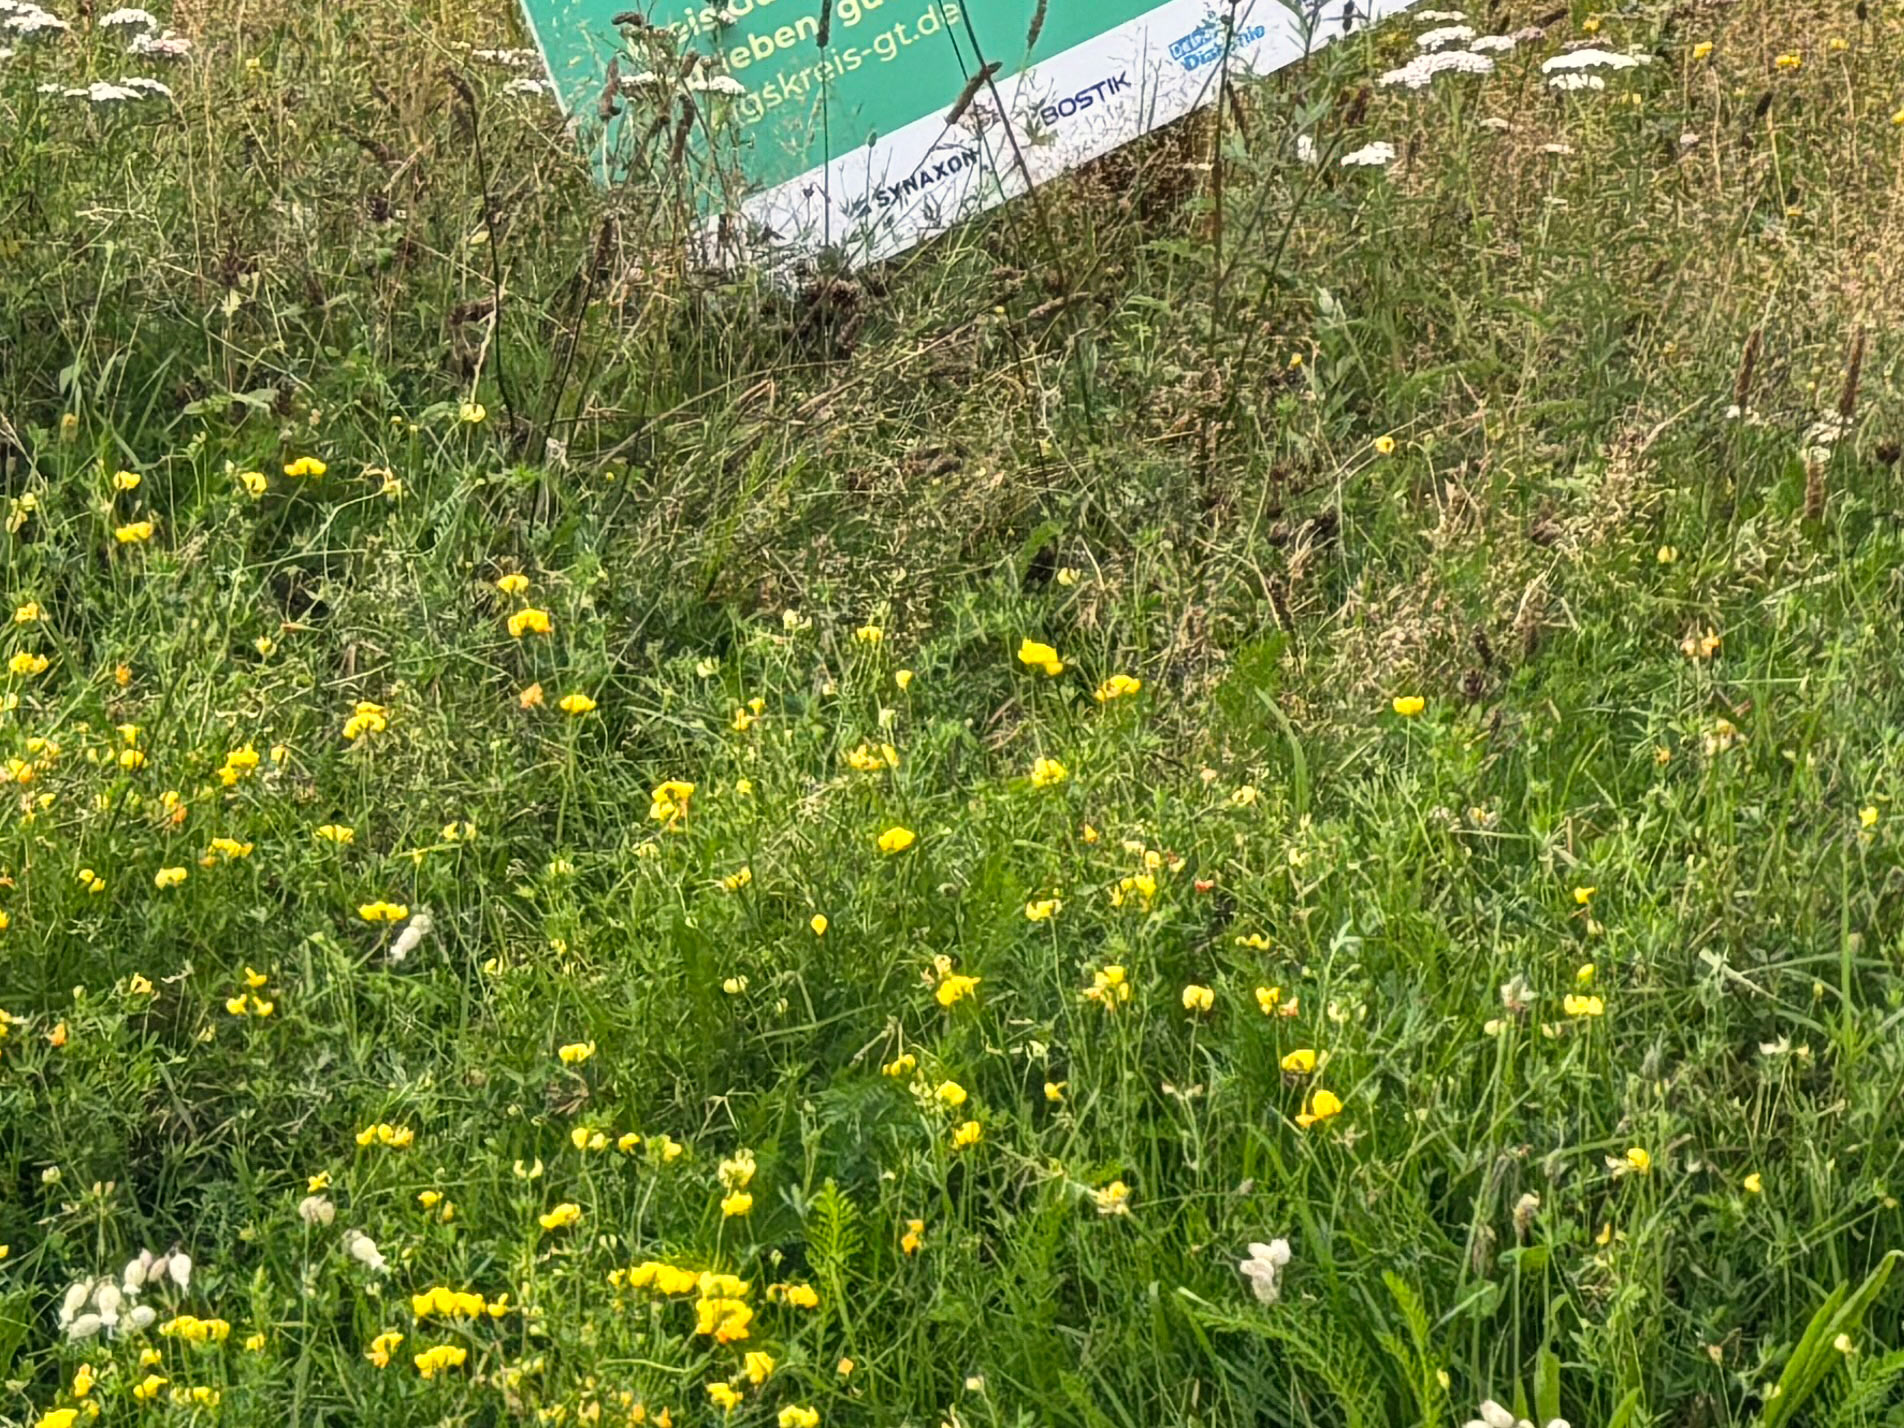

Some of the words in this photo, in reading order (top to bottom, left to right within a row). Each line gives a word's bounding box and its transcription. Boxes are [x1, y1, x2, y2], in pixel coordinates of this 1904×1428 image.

[739, 1, 961, 125] gskreis-gt.de
[1041, 70, 1133, 128] BOSTIK
[875, 148, 979, 208] SYNAXON
